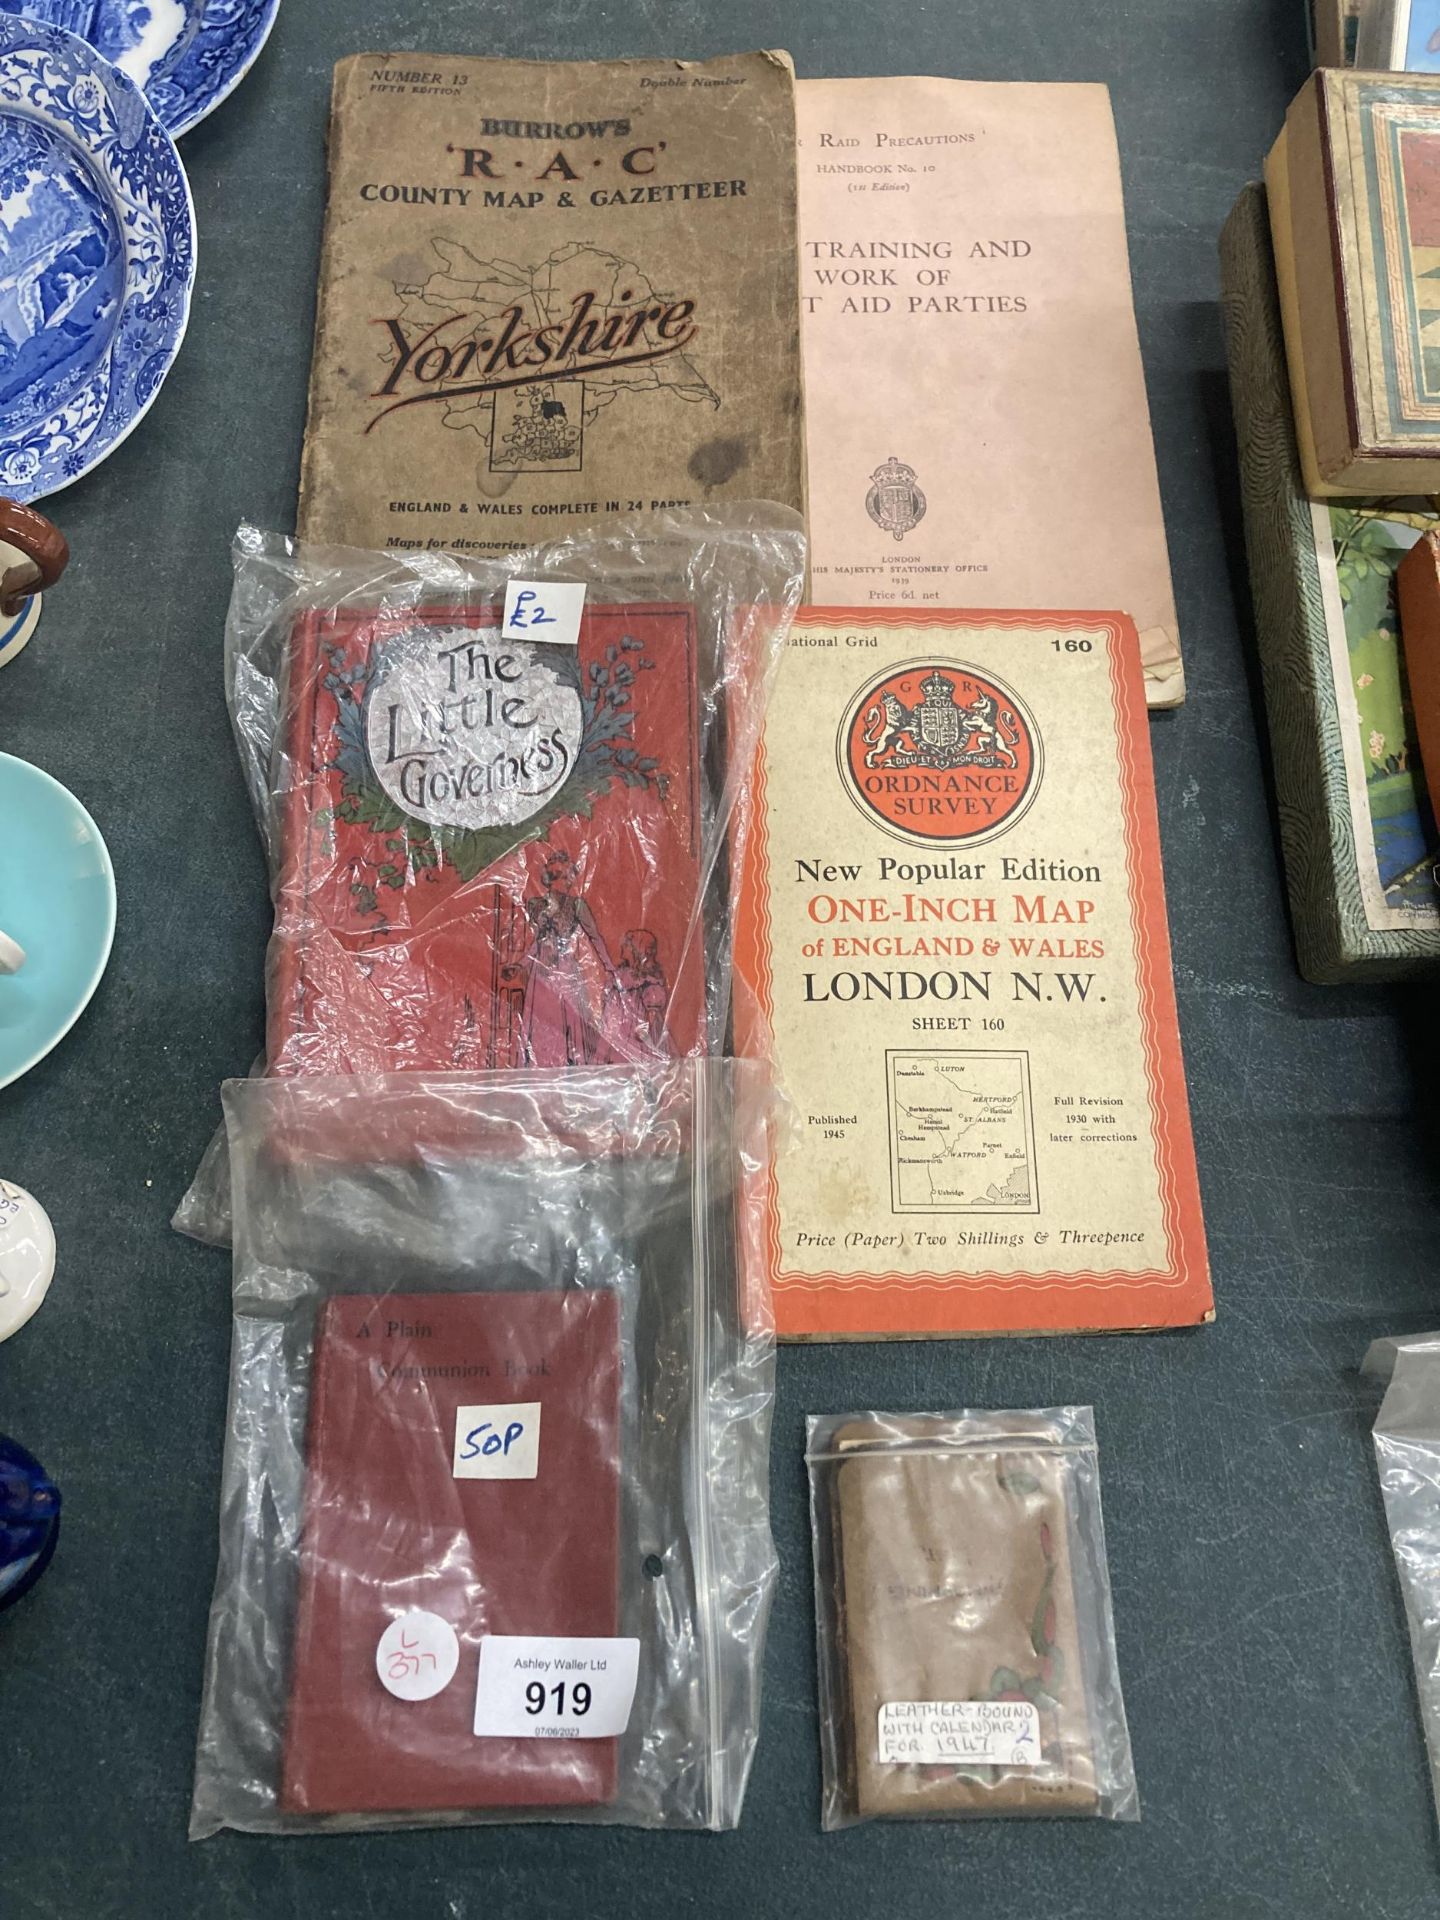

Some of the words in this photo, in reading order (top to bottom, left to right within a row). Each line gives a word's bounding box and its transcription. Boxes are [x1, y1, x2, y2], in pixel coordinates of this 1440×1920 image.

[371, 70, 443, 84] NUMBER
[453, 75, 469, 86] 13
[640, 77, 688, 89] Double
[692, 76, 747, 88] Number
[370, 84, 406, 94] FIFTH
[412, 86, 462, 96] EDITION
[480, 118, 633, 140] BURROW'S
[820, 133, 860, 148] RAID
[876, 132, 976, 148] PRECAUTIONS
[816, 164, 893, 175] HANDBOOK
[897, 164, 917, 174] No.
[923, 165, 936, 173] 10
[360, 182, 473, 207] COUNTY
[483, 190, 544, 208] MAP
[557, 192, 577, 208] &
[590, 179, 748, 206] GAZETTEER
[870, 182, 911, 193] Edition)
[805, 241, 953, 259] TRAINING
[968, 239, 1032, 258] AND
[814, 268, 898, 286] WORK
[916, 268, 951, 286] OF
[841, 296, 892, 314] AID
[908, 295, 1028, 313] PARTIES
[370, 290, 699, 398] Yorkshire
[389, 501, 451, 514] ENGLAND
[459, 502, 470, 515] &
[477, 502, 523, 515] WALES
[531, 502, 599, 516] COMPLETE
[605, 501, 620, 513] IN
[627, 500, 643, 512] 24
[386, 536, 423, 550] Maps
[427, 537, 448, 550] for
[451, 537, 528, 550] discoveries
[882, 556, 921, 564] LONDON
[834, 566, 885, 576] MAJESTY'S
[890, 565, 950, 574] STATIONERY
[955, 564, 989, 573] OFFICE
[868, 589, 896, 600] Price
[922, 590, 940, 600] net
[786, 635, 838, 647] ational
[845, 635, 878, 648] Grid
[1051, 639, 1094, 653] 160
[438, 639, 524, 694] The
[899, 681, 912, 693] G
[962, 681, 972, 693] R
[386, 687, 538, 765] Little
[399, 728, 570, 809] Governess
[895, 756, 918, 765] DIEU
[921, 756, 931, 764] ET
[952, 756, 971, 764] MON
[973, 756, 995, 764] DROIT
[865, 775, 1019, 794] ORDNANCE
[894, 797, 998, 816] SURVEY
[795, 859, 862, 882] New
[878, 857, 986, 885] Popular
[1000, 858, 1102, 882] Edition
[807, 894, 998, 924] ONE-INCH
[1012, 895, 1095, 924] MAP
[801, 938, 825, 958] of
[832, 937, 974, 957] ENGLAND
[981, 937, 1001, 956] &
[1008, 938, 1105, 959] WALES
[802, 971, 993, 1002] LONDON
[1011, 972, 1107, 1002] N.W.
[912, 1017, 971, 1031] SHEET
[981, 1017, 1006, 1031] 160
[1054, 1096, 1073, 1107] Full
[1079, 1096, 1124, 1107] Revision
[808, 1115, 857, 1126] Published
[1066, 1114, 1087, 1124] 1930
[1093, 1114, 1116, 1124] with
[823, 1130, 845, 1140] 1945
[1050, 1132, 1073, 1143] later
[1080, 1132, 1138, 1143] corrections
[796, 1232, 837, 1247] Price
[843, 1232, 905, 1249] (Paper)
[914, 1231, 948, 1247] Two
[957, 1230, 1025, 1248] Shillings
[1033, 1230, 1050, 1245] &
[1060, 1230, 1146, 1248] Threepence
[356, 1321, 370, 1338] A
[386, 1320, 432, 1338] Plain
[514, 1657, 551, 1673] Ashley
[554, 1658, 587, 1671] Waller
[590, 1659, 607, 1671] Ltd
[525, 1681, 592, 1716] 919
[883, 1721, 923, 1735] WITH
[930, 1720, 1016, 1737] CALENDAR
